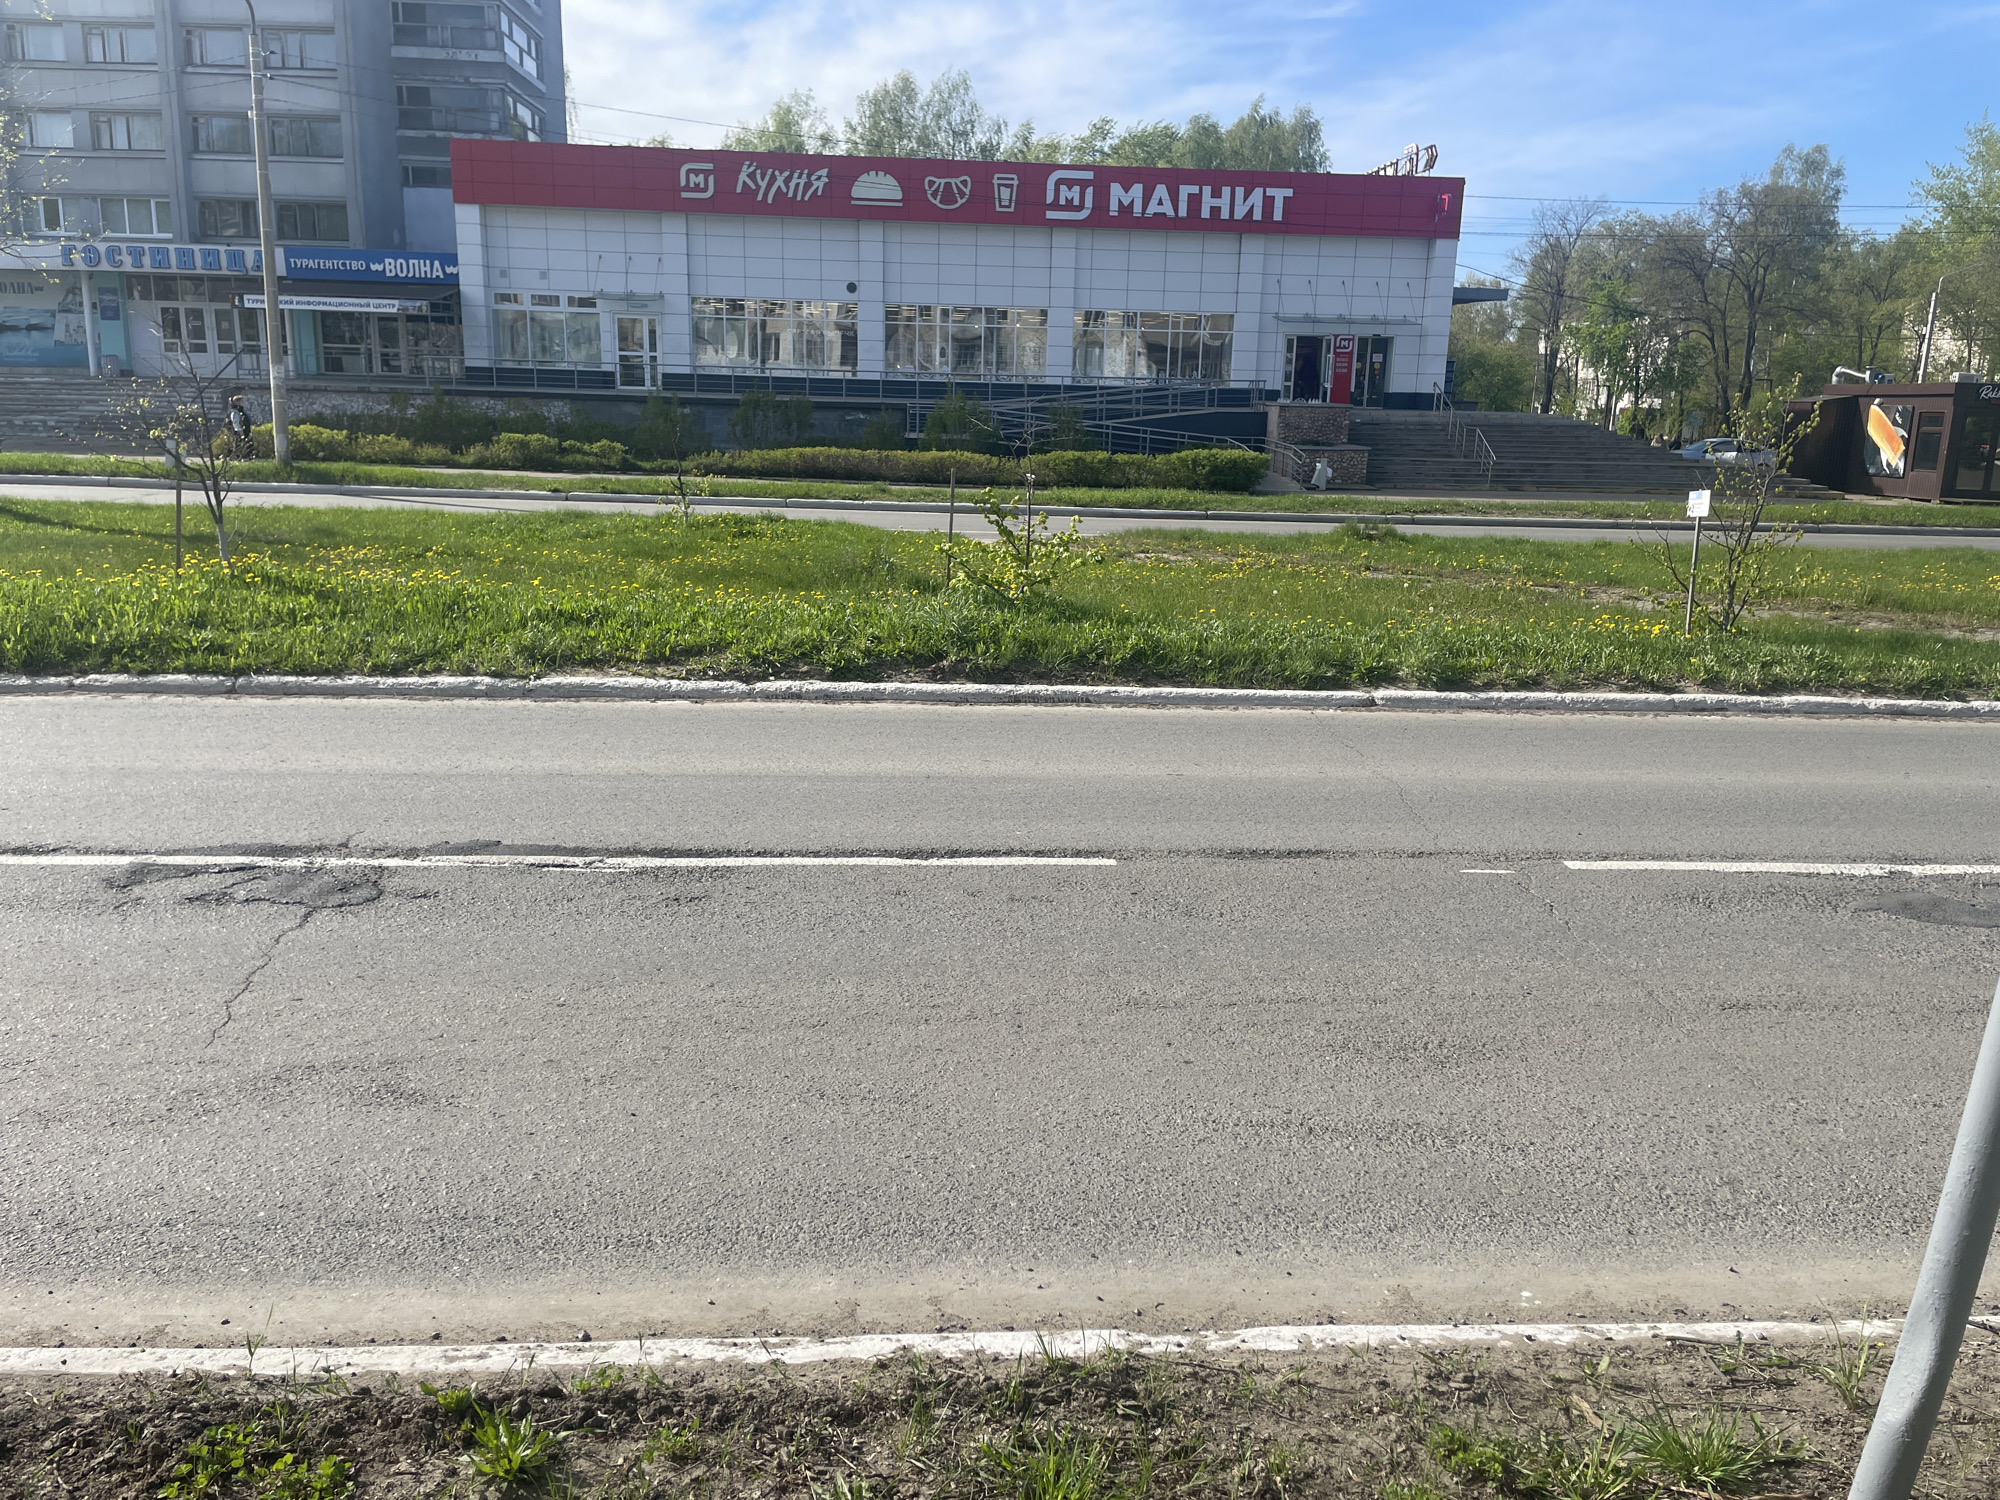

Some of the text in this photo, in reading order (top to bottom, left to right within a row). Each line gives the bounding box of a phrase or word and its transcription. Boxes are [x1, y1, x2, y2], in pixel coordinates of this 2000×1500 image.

[1109, 182, 1294, 222] МАГНИТ
[289, 257, 444, 279] ТУРАГЕНТСТВО ВОЛНА
[246, 298, 396, 310] ТУРИКИЙ ИНФОРМАЦИОННЫЙ ЦЕНТР
